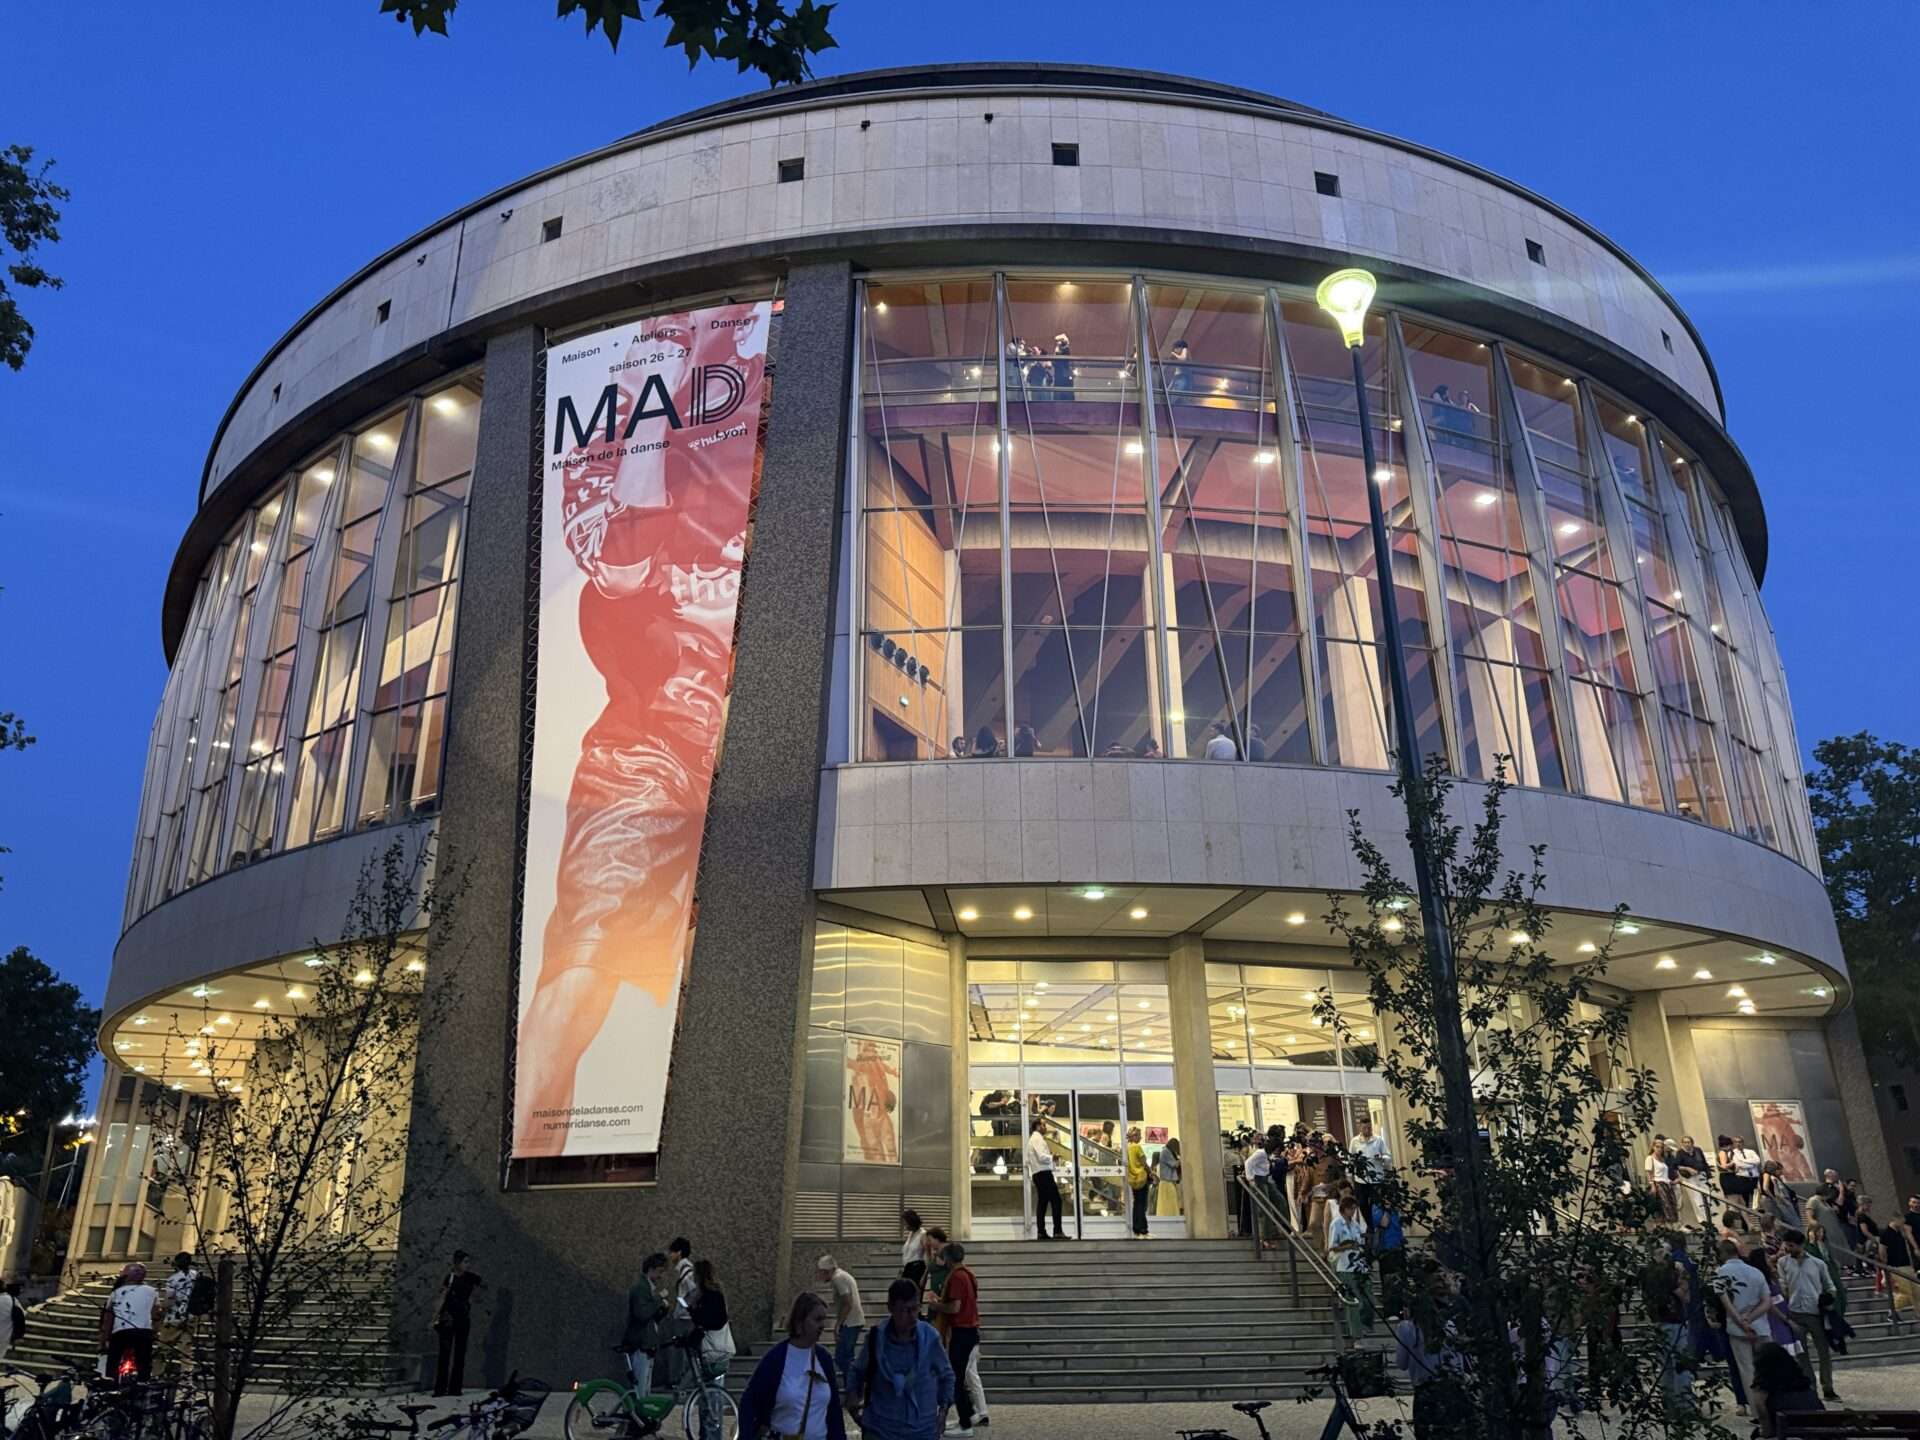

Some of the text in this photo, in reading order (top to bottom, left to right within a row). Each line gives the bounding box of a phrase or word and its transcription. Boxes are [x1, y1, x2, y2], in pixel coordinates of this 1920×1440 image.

[561, 346, 601, 365] Maison
[631, 328, 677, 345] Ateliers
[711, 318, 751, 330] Danse
[608, 357, 647, 374] saison
[649, 352, 665, 364] 26
[677, 347, 692, 359] 27
[553, 363, 746, 455] MAD
[551, 440, 671, 472] Maison de la danse
[532, 1104, 644, 1119] maisondeladanse.com
[543, 1118, 631, 1131] numeridanse.com
